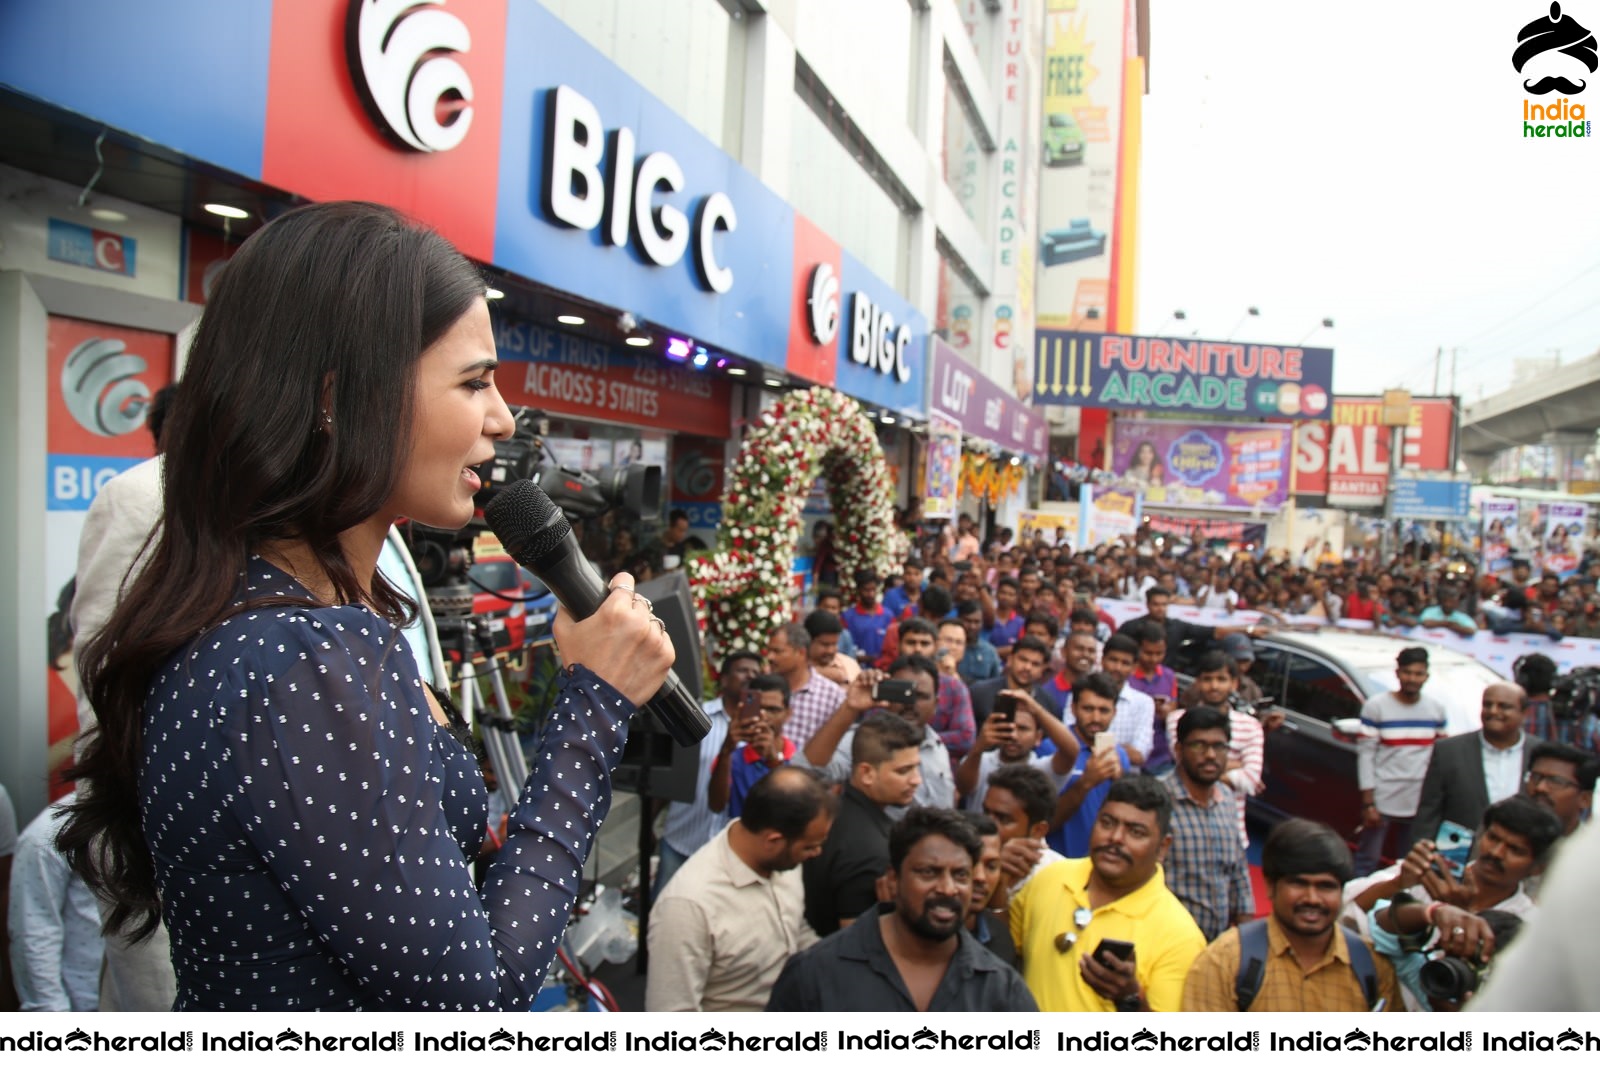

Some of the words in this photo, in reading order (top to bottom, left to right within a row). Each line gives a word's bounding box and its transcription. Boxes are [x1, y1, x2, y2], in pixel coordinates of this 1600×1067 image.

[541, 84, 690, 268] BIG
[691, 191, 738, 294] C
[1000, 138, 1018, 266] ARCADE
[529, 326, 554, 358] OF
[560, 333, 610, 372] TRUST
[850, 290, 895, 375] BIG
[894, 324, 912, 383] C
[1100, 336, 1303, 380] FURNITURE
[524, 362, 593, 403] ACROSS
[597, 379, 606, 408] 3
[608, 381, 659, 417] STATES
[1099, 371, 1247, 410] ARCADE
[1297, 424, 1422, 474] SALE
